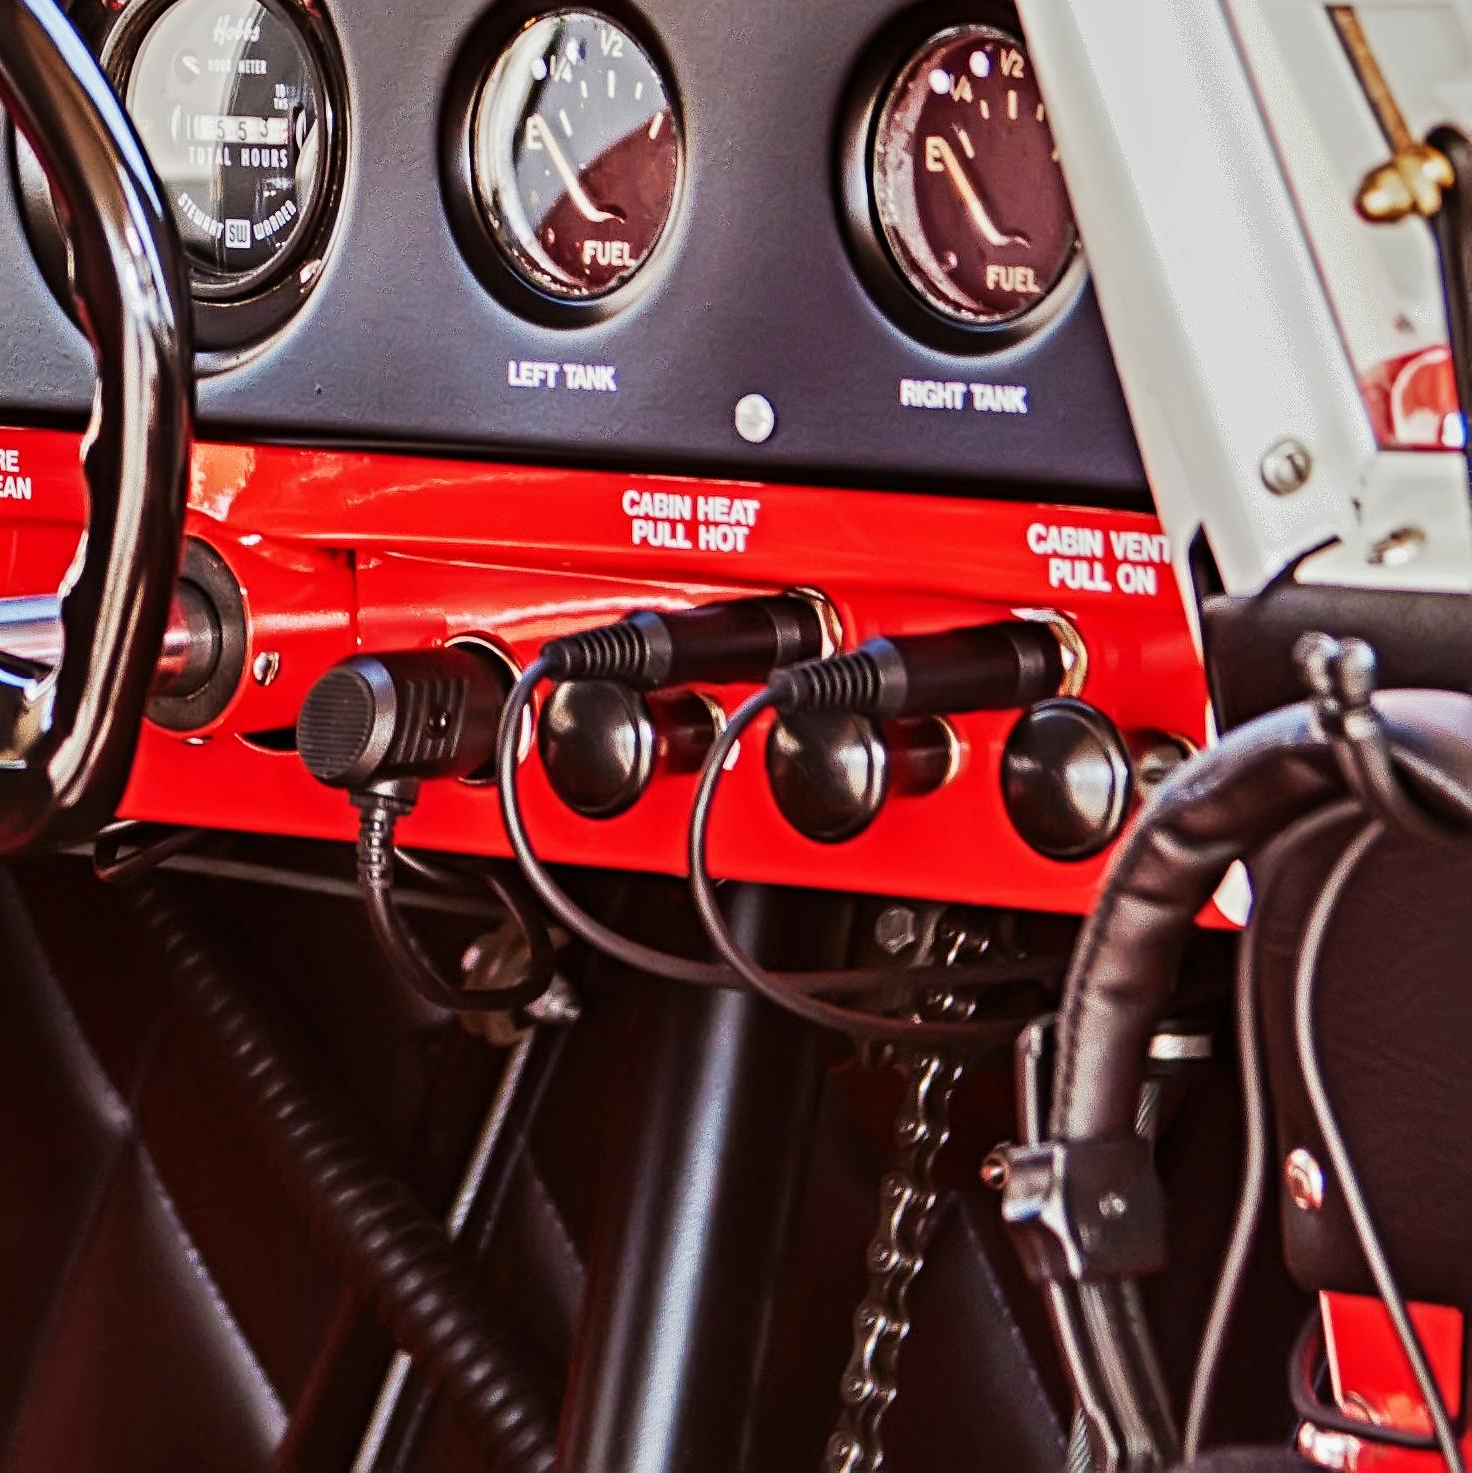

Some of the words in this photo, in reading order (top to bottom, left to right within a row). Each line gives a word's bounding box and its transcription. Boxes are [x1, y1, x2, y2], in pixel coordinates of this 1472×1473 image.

[237, 59, 268, 76] METER
[188, 146, 233, 167] TOTAL
[239, 147, 289, 169] HOURS
[177, 191, 225, 240] STEWART
[252, 198, 297, 241] WARNER
[582, 239, 638, 268] FUEL
[986, 263, 1043, 294] FUEL
[507, 360, 561, 389] LEFT
[563, 362, 617, 392] TANK
[900, 379, 967, 411] RIGHT
[970, 383, 1029, 415] TANK
[622, 490, 692, 522] CABIN
[697, 495, 760, 527] HEAT
[631, 519, 692, 551] PULL
[698, 523, 749, 553] HOT
[1026, 522, 1104, 559] CABIN
[1109, 530, 1171, 565] VENT
[1049, 557, 1113, 593] PULL
[1116, 562, 1157, 596] ON
